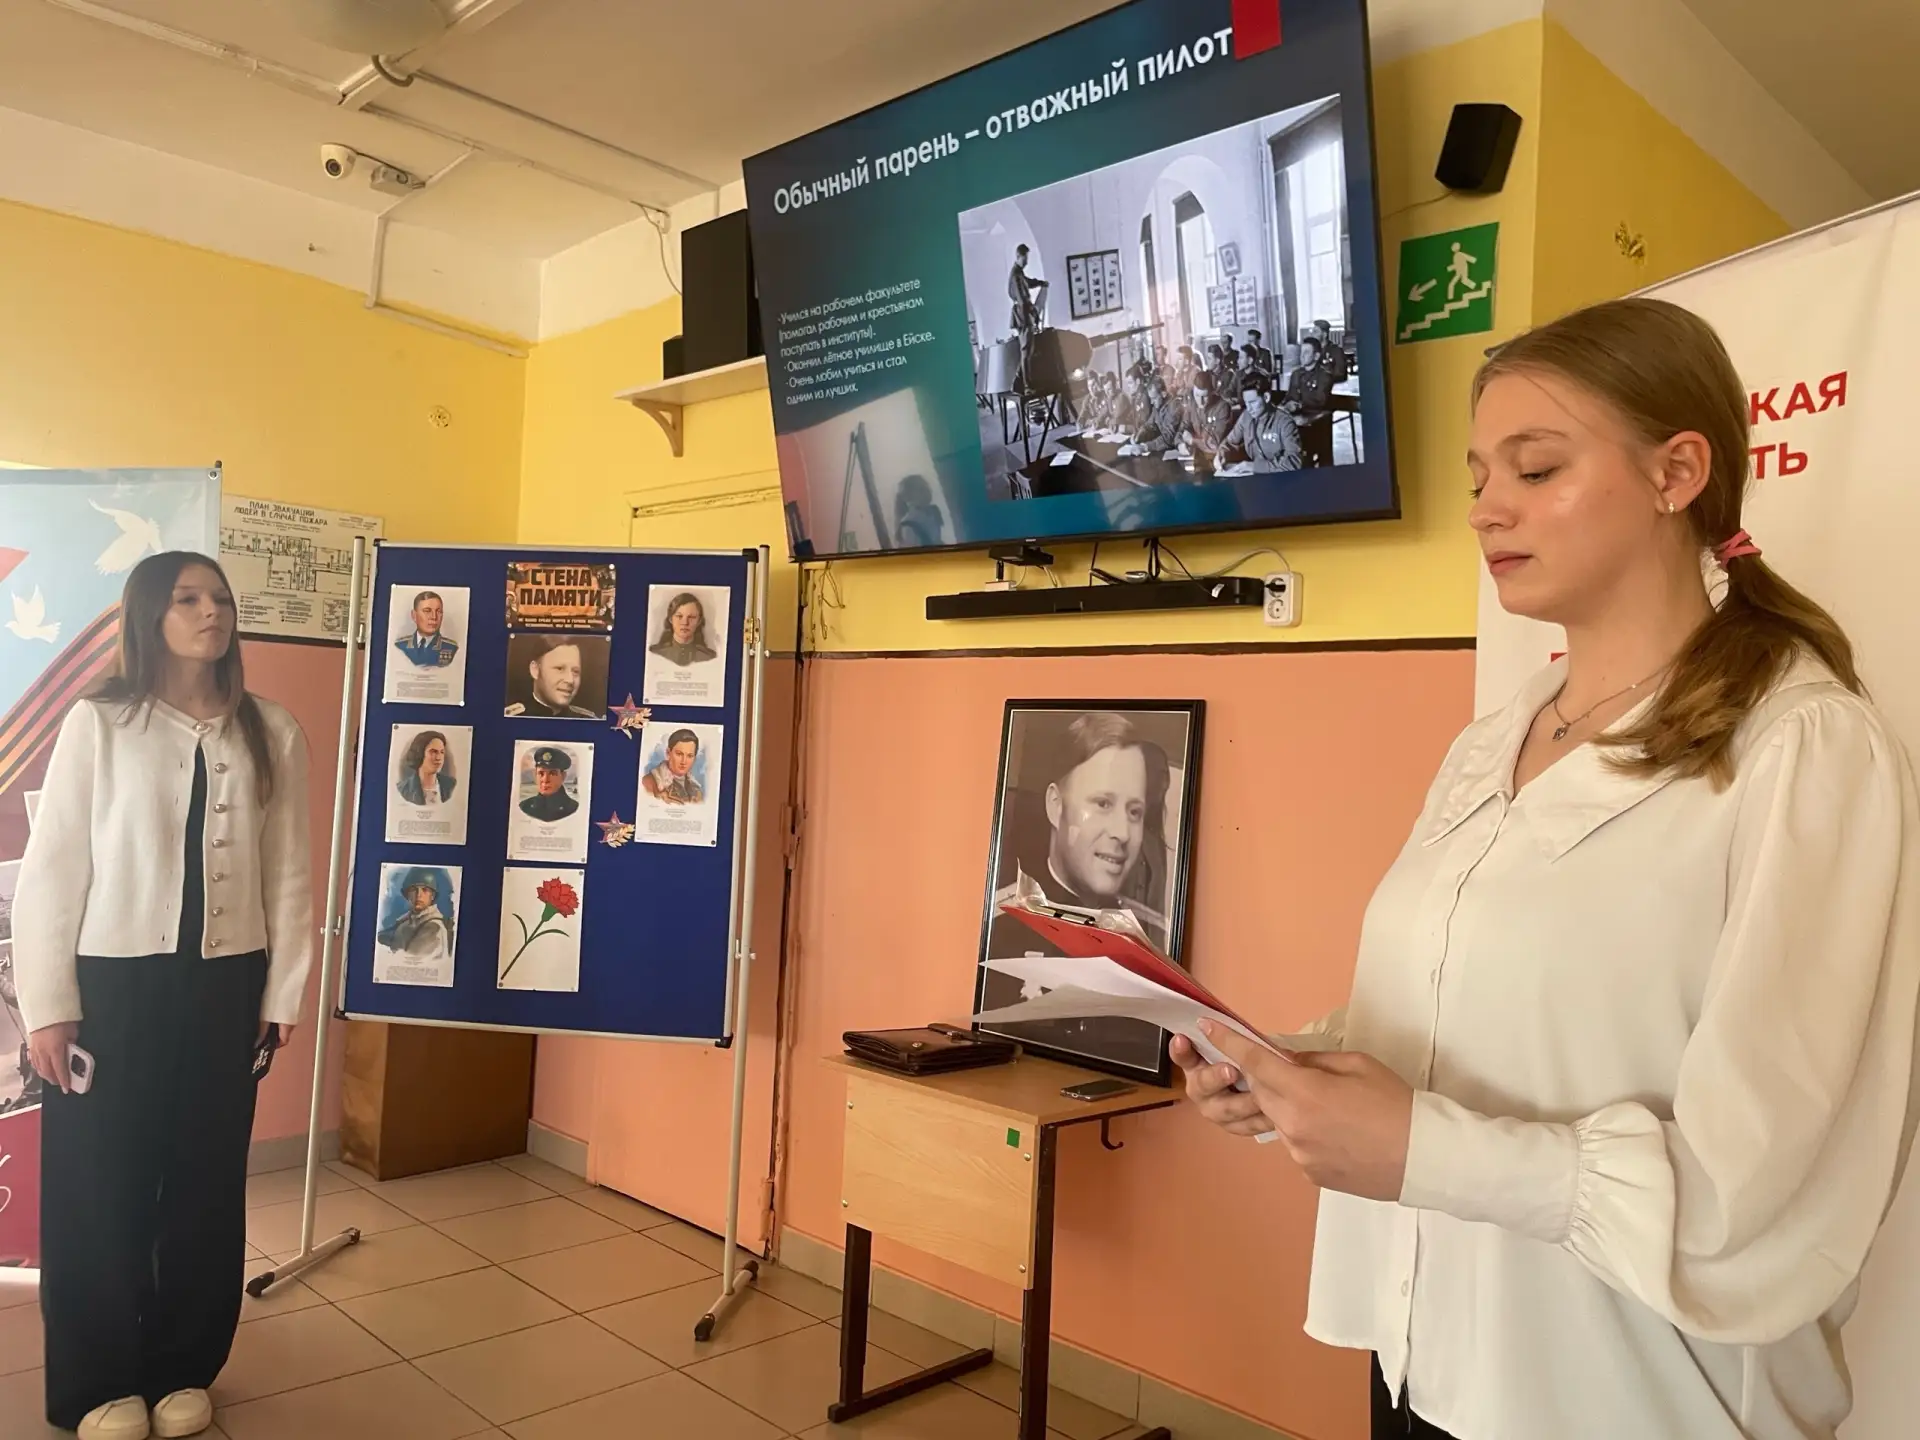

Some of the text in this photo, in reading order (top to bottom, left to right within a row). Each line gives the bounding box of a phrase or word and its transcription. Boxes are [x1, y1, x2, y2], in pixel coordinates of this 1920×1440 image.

[774, 156, 869, 214] Обычный
[875, 132, 960, 176] парень
[986, 58, 1129, 139] отважный
[1138, 27, 1232, 86] пилот
[810, 306, 821, 316] на
[823, 295, 864, 314] рабочем
[865, 279, 920, 302] факультете
[818, 313, 858, 334] рабочим
[860, 312, 866, 320] и
[867, 297, 924, 320] крестьянам
[781, 339, 820, 357] поступать
[822, 339, 827, 348] в
[823, 349, 853, 364] лётное
[855, 340, 894, 360] училище
[896, 338, 901, 347] в
[903, 330, 935, 347] Ейске.
[815, 369, 842, 383] любил
[844, 361, 875, 379] учиться
[877, 360, 883, 369] и
[885, 355, 907, 368] стал
[786, 391, 813, 405] одним
[815, 389, 825, 400] из
[1750, 371, 1848, 425] КАЯ
[1749, 442, 1808, 479] ТЬ
[234, 506, 258, 517] ЛЮДЕЙ
[269, 511, 296, 522] СЛУЧАЕ
[300, 516, 328, 526] ПОЖАРА
[249, 501, 315, 517] ПЛАН ЭВАКУАЦИИ
[531, 569, 592, 586] СТЕНА
[520, 589, 601, 606] ПАМЯТИ
